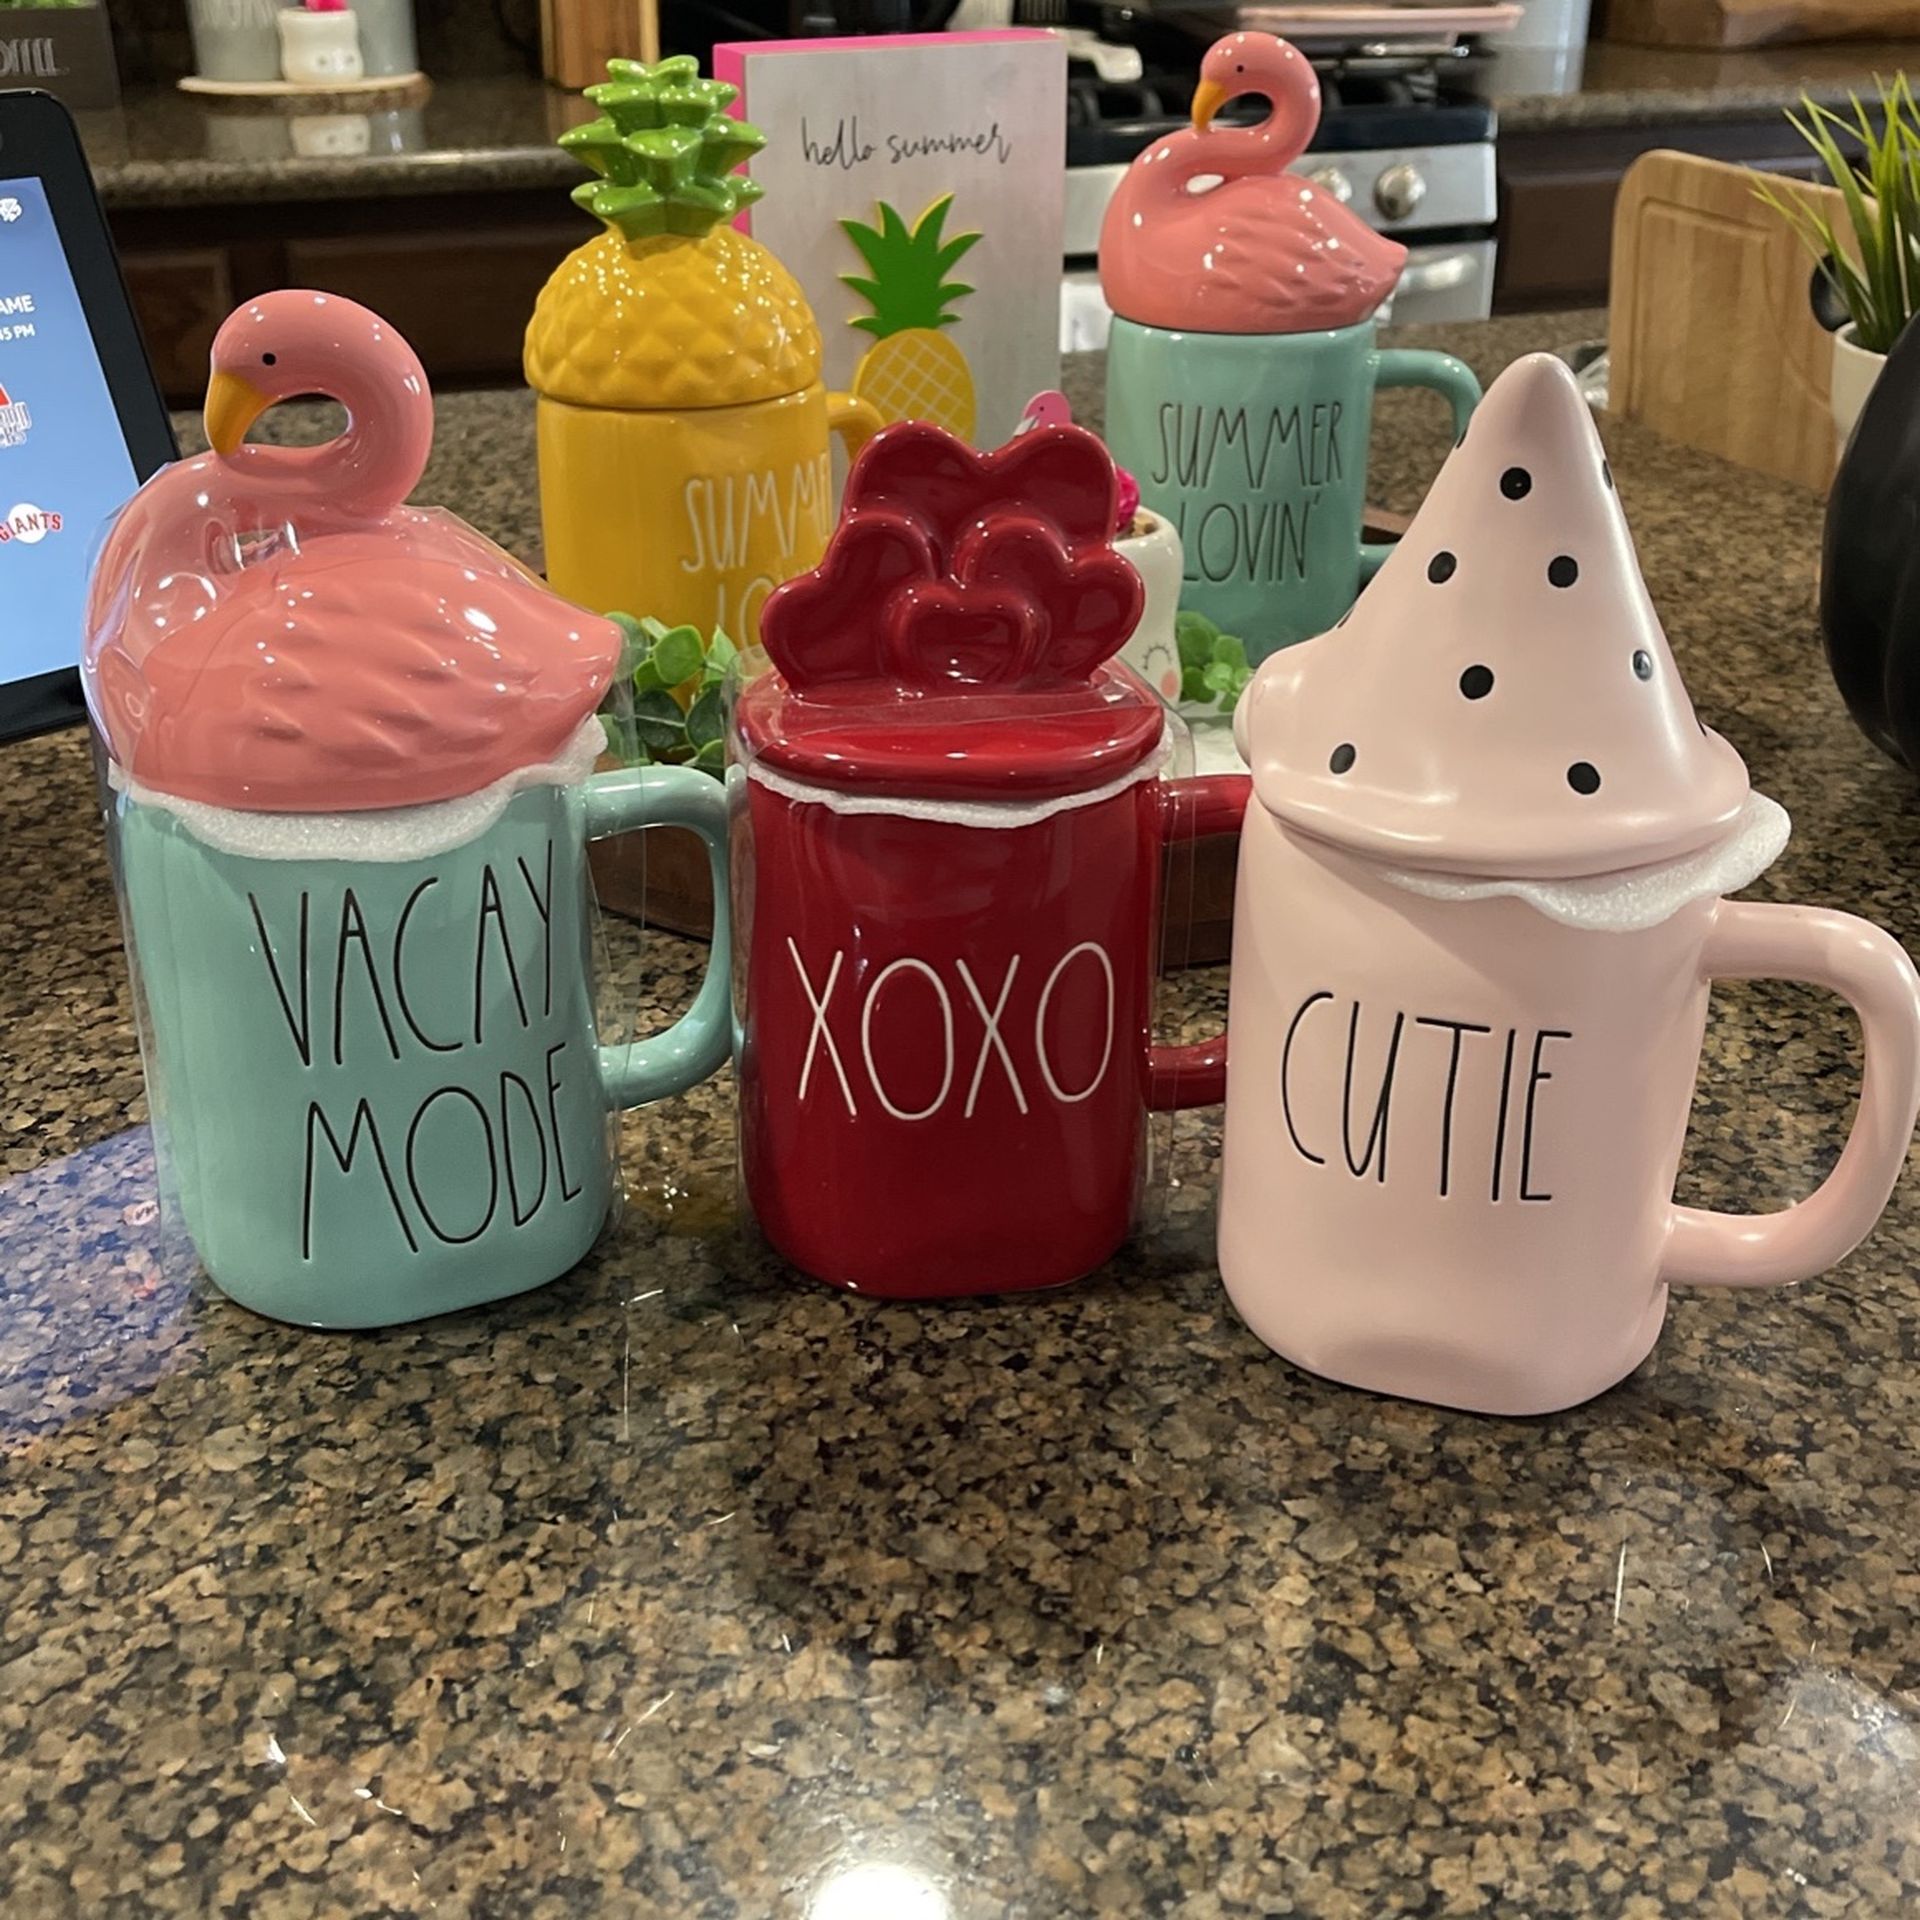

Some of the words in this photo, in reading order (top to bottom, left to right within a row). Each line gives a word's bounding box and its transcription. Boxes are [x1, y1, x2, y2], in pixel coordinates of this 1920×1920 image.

[802, 115, 875, 170] hello
[887, 122, 1011, 163] summer
[13, 323, 36, 339] PM
[1152, 401, 1342, 489] SUMMER
[0, 512, 62, 541] GIANTS
[248, 839, 554, 1067] VACAY
[787, 936, 1114, 1121] XOXO
[1281, 991, 1572, 1202] CUTIE
[302, 1041, 583, 1260] MODE
